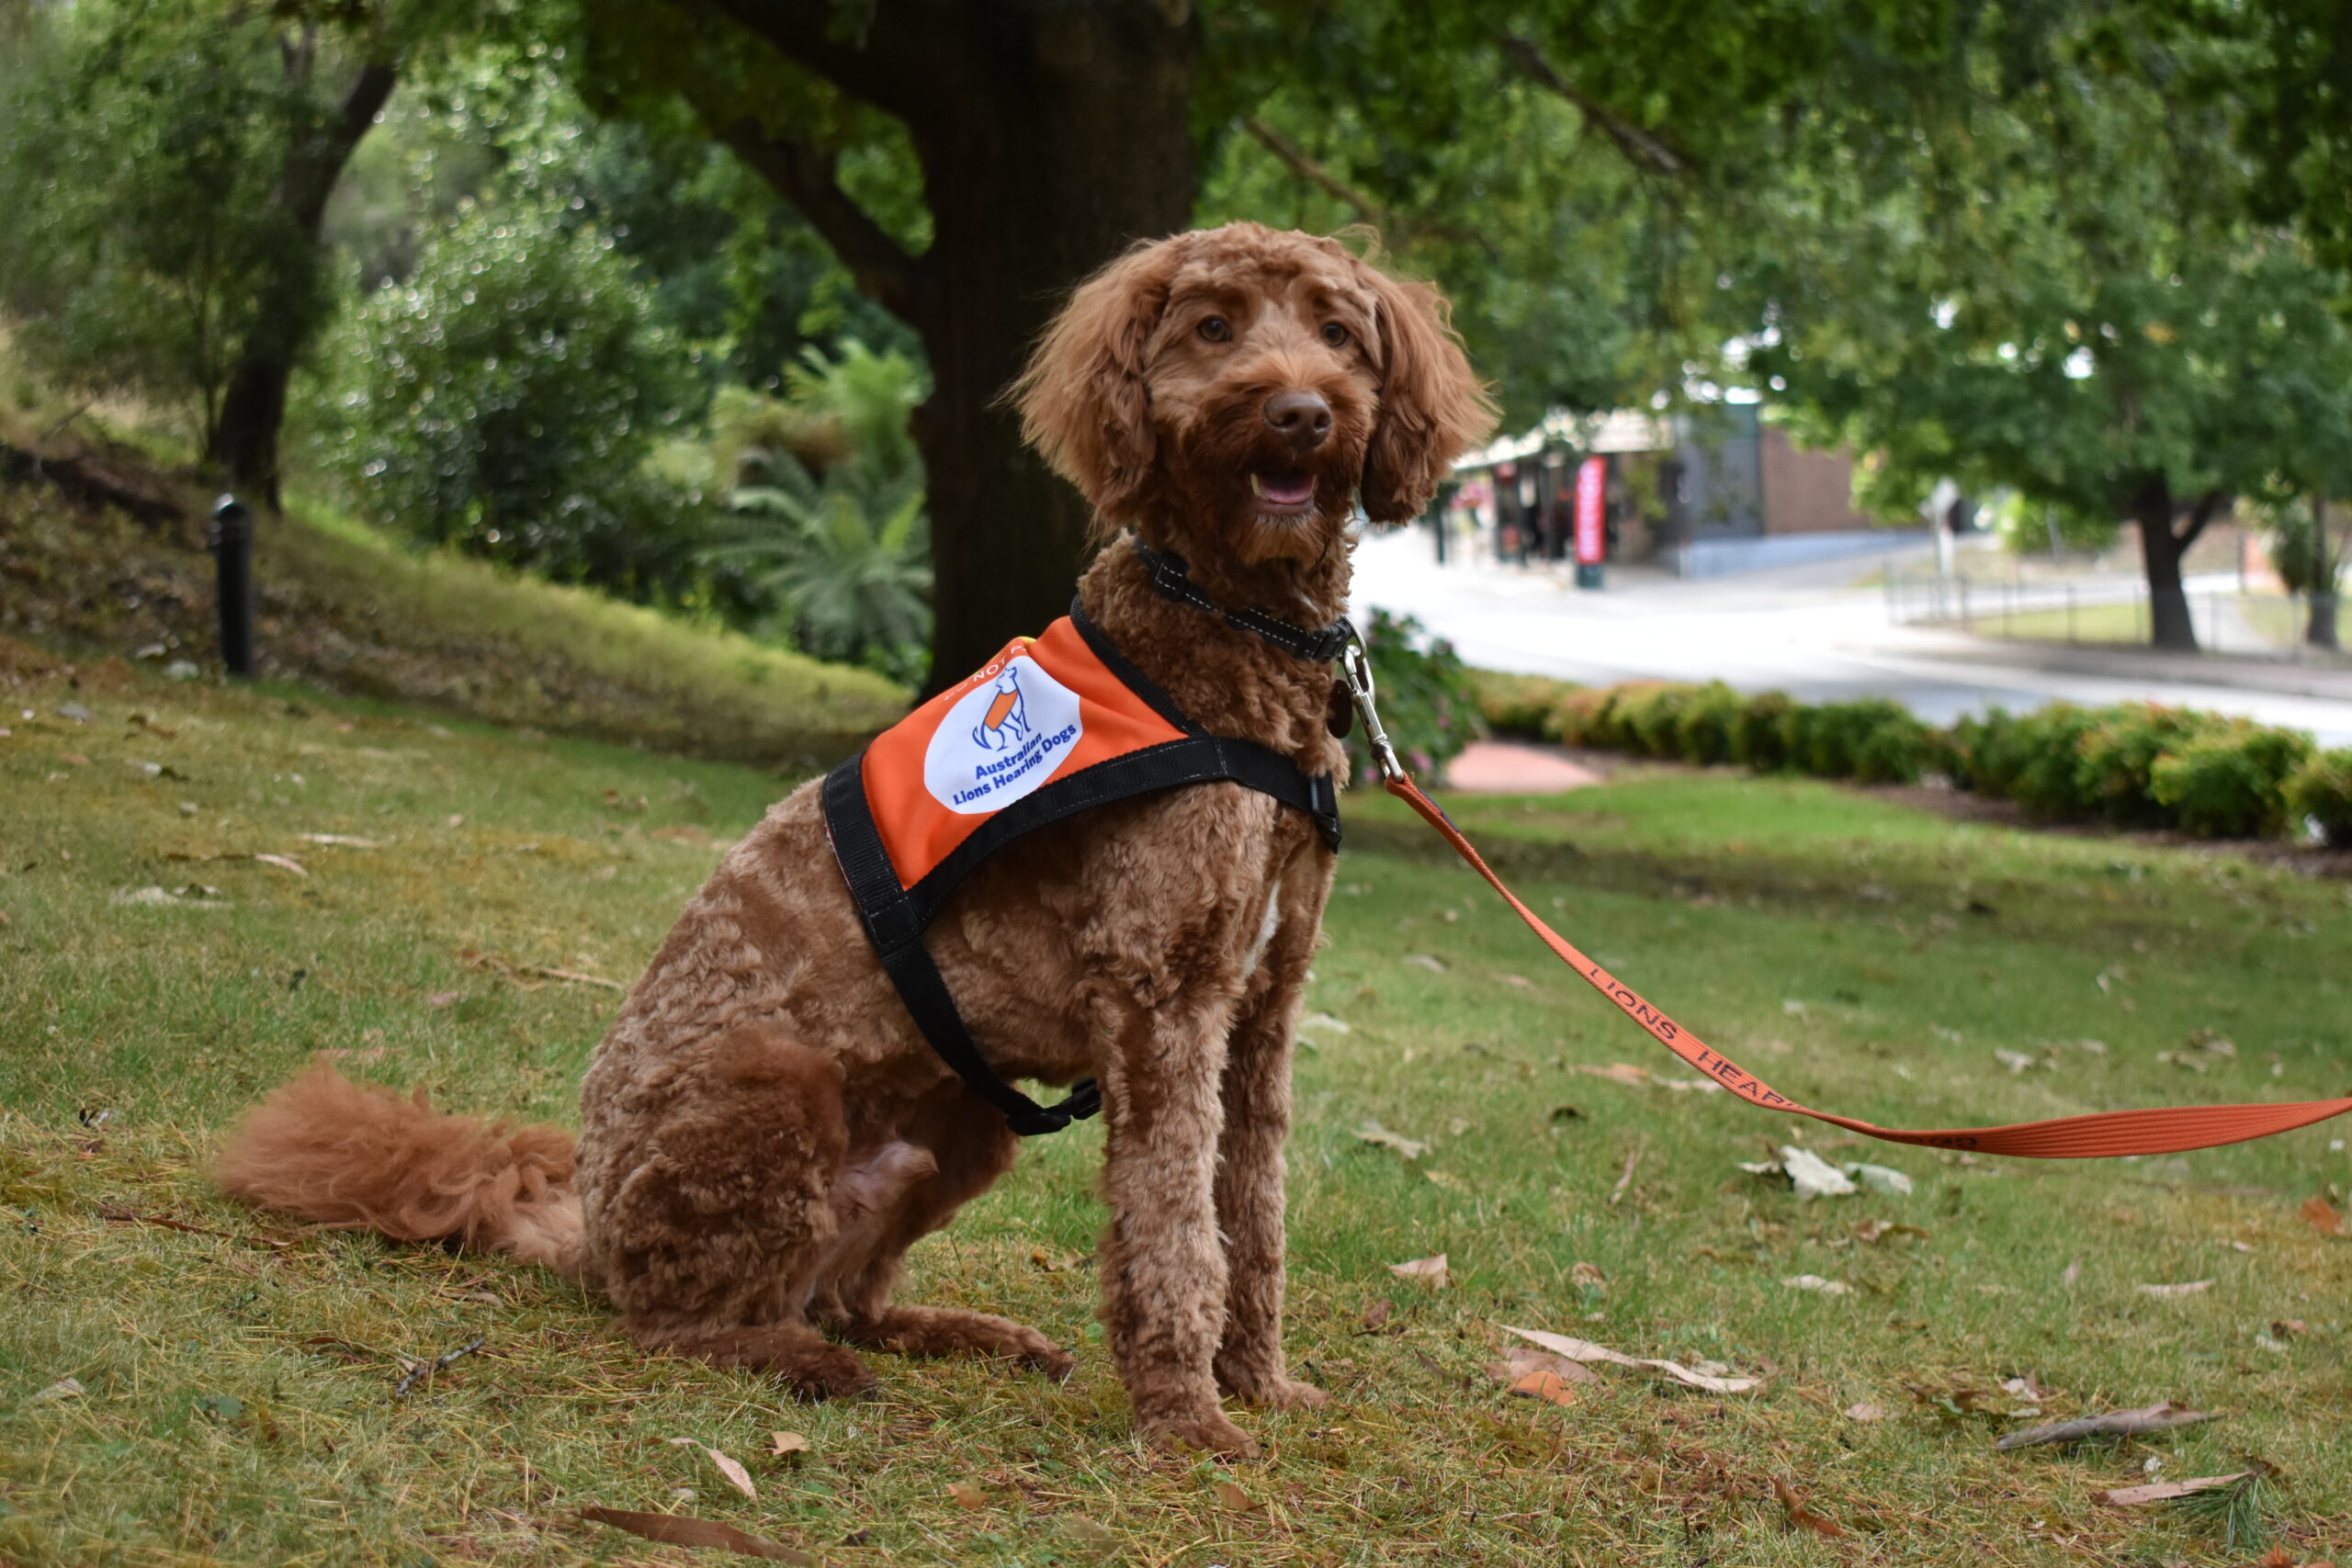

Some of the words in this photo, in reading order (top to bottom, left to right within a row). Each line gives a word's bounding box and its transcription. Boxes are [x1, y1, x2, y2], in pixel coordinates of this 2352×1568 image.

[973, 654, 1007, 682] NOT
[953, 783, 992, 806] Lions
[992, 749, 1044, 790] Hearing
[1041, 724, 1078, 754] Dogs
[975, 732, 1043, 780] Australian
[1589, 968, 1678, 1040] LIONS
[1697, 1050, 1801, 1108] HEAR
